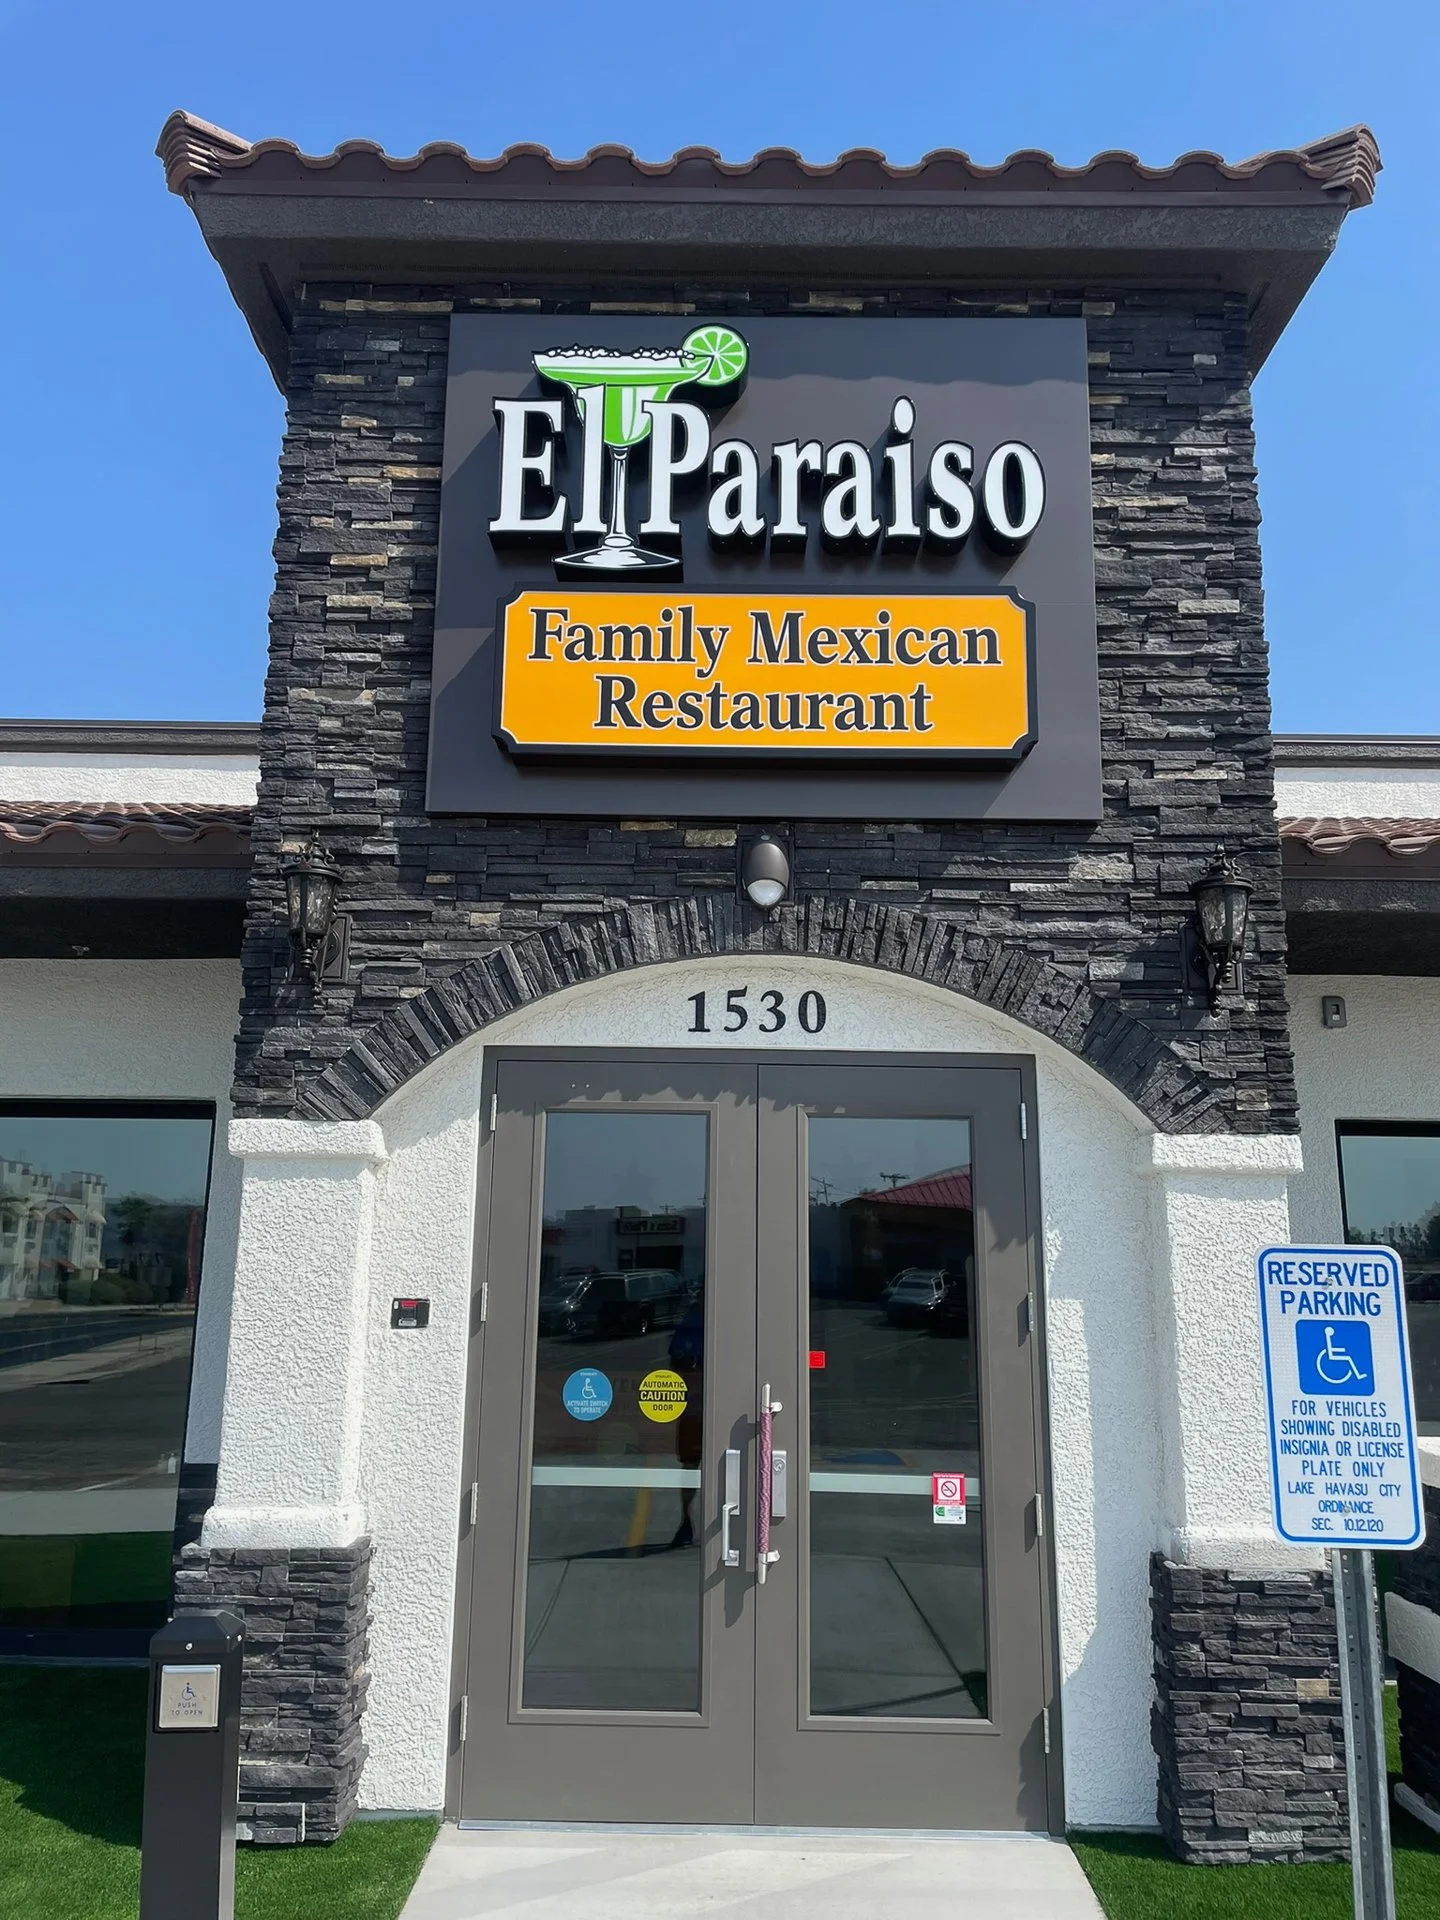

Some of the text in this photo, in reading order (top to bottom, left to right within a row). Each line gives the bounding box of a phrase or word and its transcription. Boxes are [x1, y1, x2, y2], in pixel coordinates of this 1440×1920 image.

[489, 383, 1046, 539] El Paraiso
[527, 606, 1002, 677] Family Mexican
[593, 675, 934, 734] Restaurant
[687, 985, 827, 1034] 1530
[1267, 1261, 1389, 1287] RESERVED
[1280, 1290, 1381, 1316] PARKING
[643, 1381, 685, 1389] AUTOMATIC
[640, 1391, 686, 1401] CAUTION
[1292, 1400, 1387, 1418] FOR VEHICLES
[1281, 1419, 1401, 1438] SHOWING DISABLED
[1280, 1439, 1405, 1458] INSIGNIA OR LICENSE
[1302, 1460, 1385, 1477] PLATE ONLY
[1288, 1481, 1401, 1497] LAKE HAVASU CITY
[1318, 1500, 1375, 1514] ORDINANCE
[1311, 1518, 1333, 1531] SEC.
